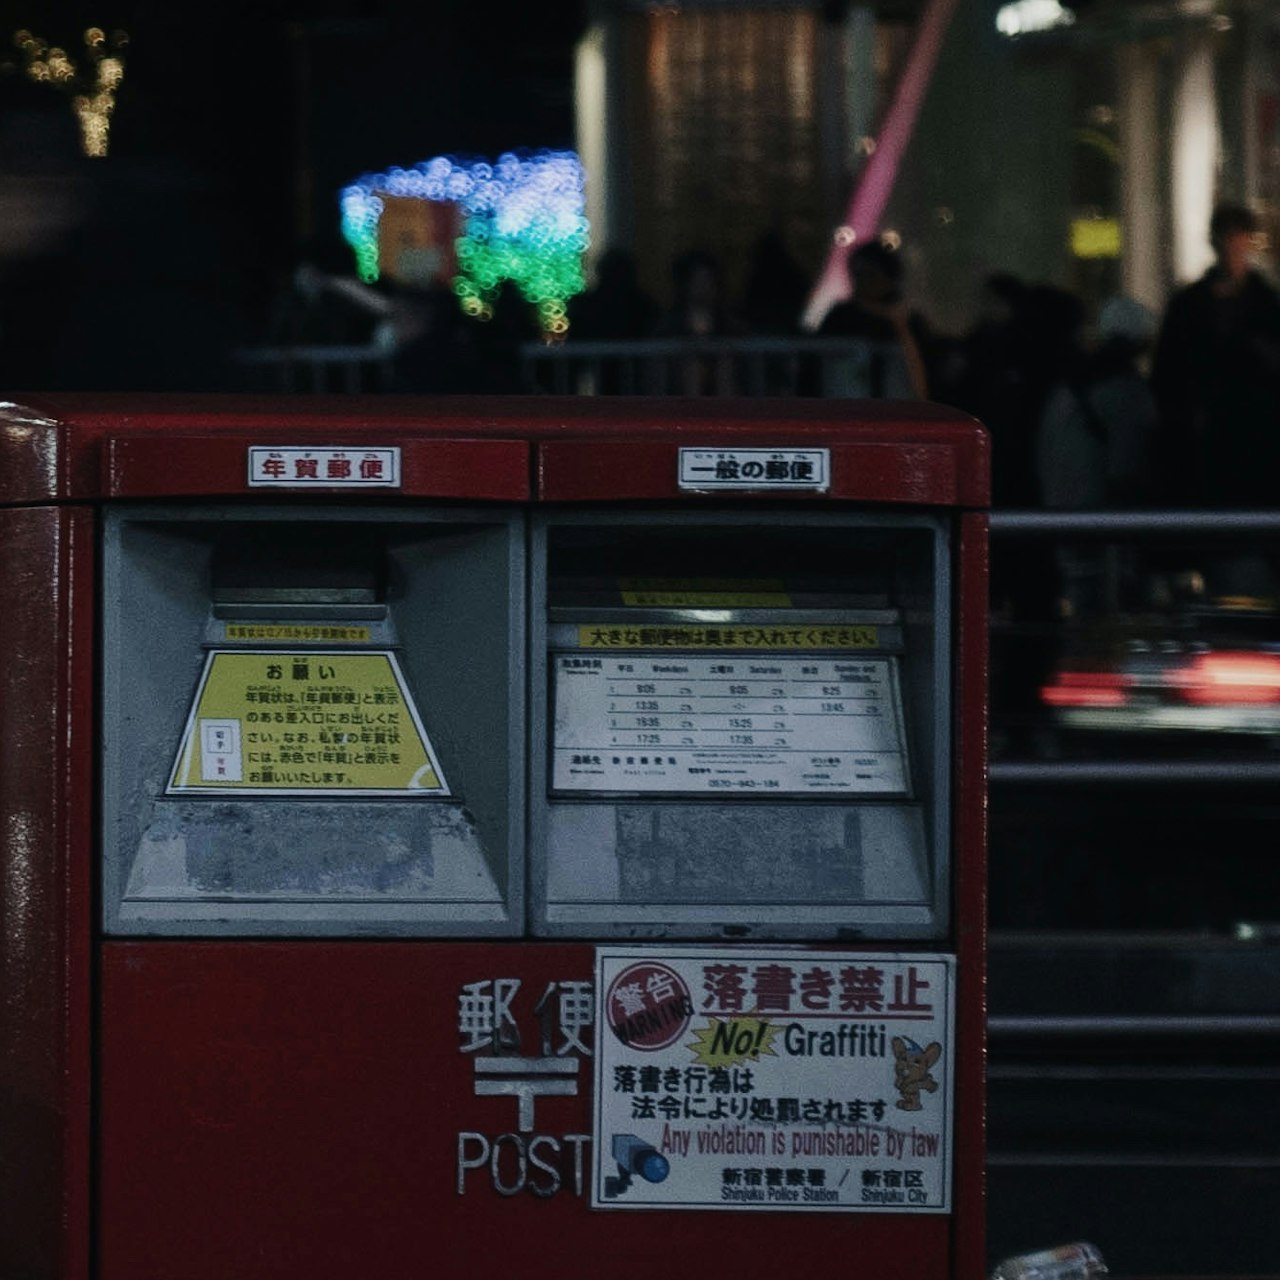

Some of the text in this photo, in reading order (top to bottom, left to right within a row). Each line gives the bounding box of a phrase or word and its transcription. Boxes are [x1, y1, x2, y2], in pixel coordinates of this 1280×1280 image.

[262, 459, 384, 479] 年賀郵便
[690, 460, 814, 480] 一般の郵便
[590, 628, 875, 646] 大きな郵便物は奥まで入れてください。
[266, 664, 336, 680] お願い
[245, 692, 400, 705] 年賀状は、「年賀郵便」と表示
[246, 711, 401, 725] のある差入口にお出しくだ
[248, 752, 401, 765] には、赤色で「年賀」と表示を
[249, 771, 354, 784] お願いいたします。
[614, 972, 676, 1018] 警告
[702, 963, 933, 1012] 落書き禁止
[458, 977, 593, 1057] 郵便
[613, 995, 695, 1046] WARNING
[709, 1022, 887, 1058] No! Graffiti
[613, 1065, 755, 1094] 落書き行為は
[631, 1095, 888, 1121] 法令により処罰されます
[661, 1123, 939, 1159] Any violation is punishable by law
[456, 1131, 593, 1198] POST
[722, 1168, 826, 1187] 新宿警察署
[861, 1169, 924, 1188] 新宿区
[721, 1186, 928, 1204] Shinjuku Police Station Shinjuku City
